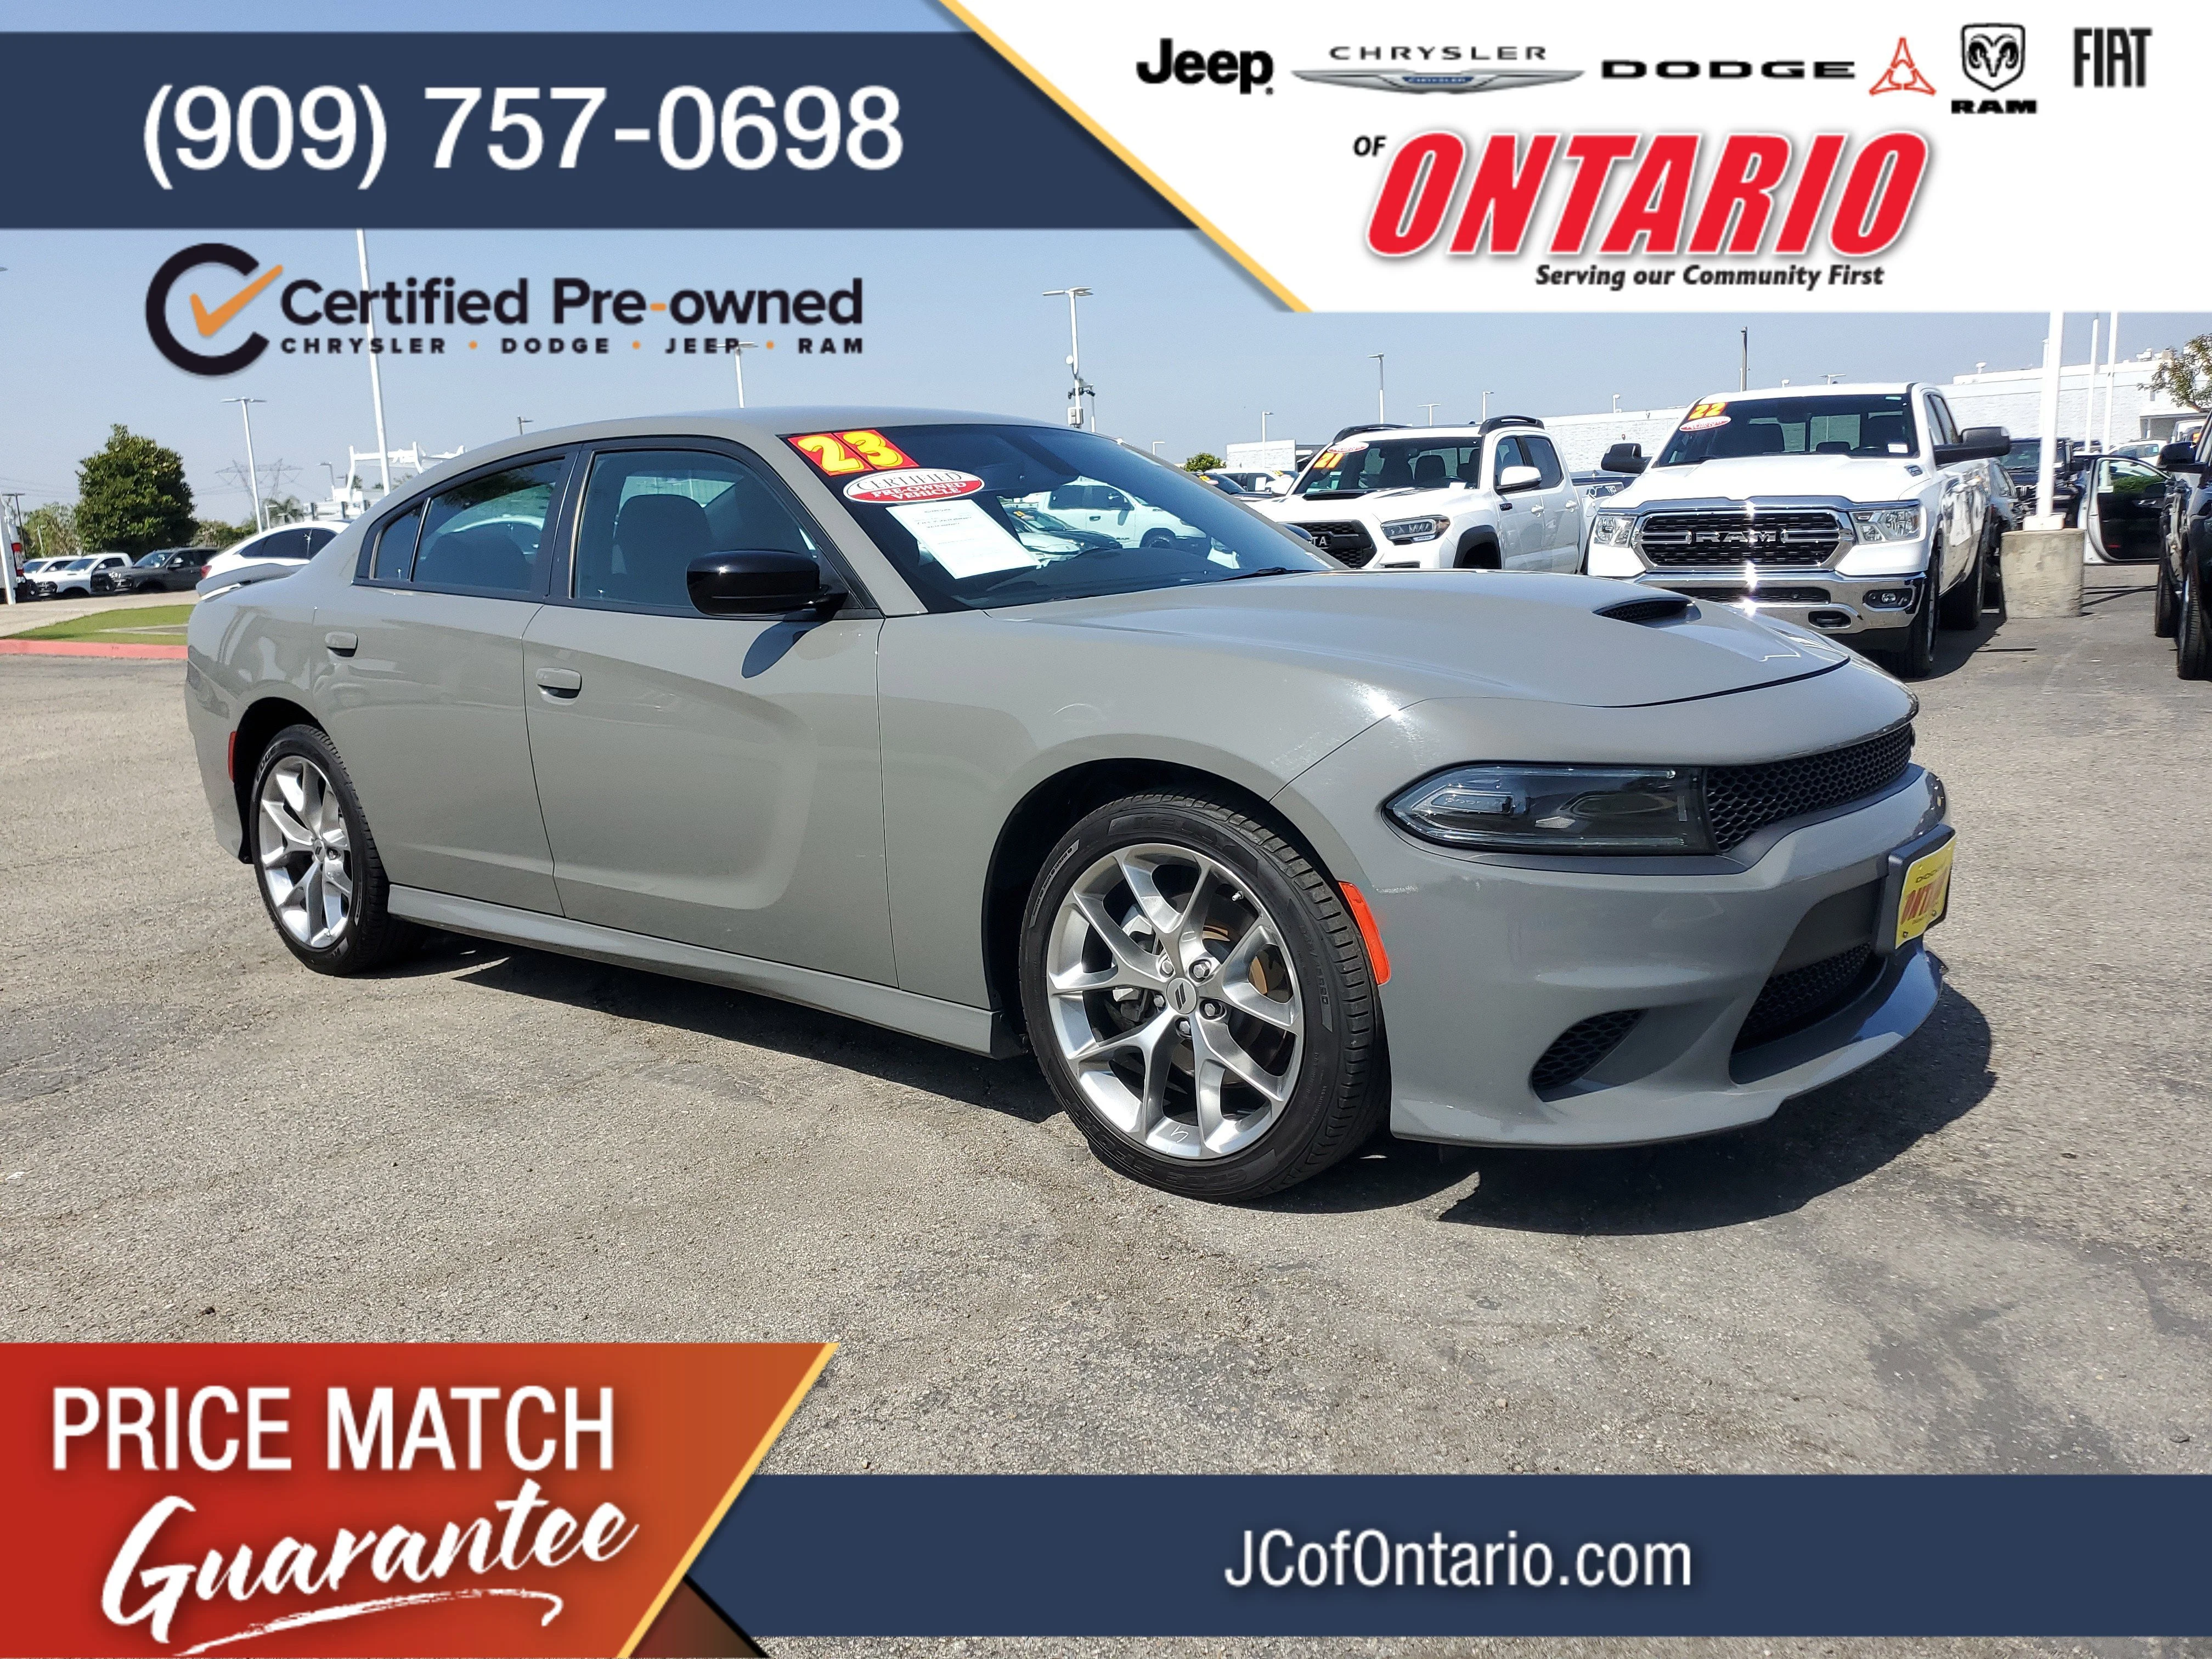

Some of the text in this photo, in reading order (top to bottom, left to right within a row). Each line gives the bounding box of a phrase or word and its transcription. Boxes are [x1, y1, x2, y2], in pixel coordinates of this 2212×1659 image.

[797, 431, 904, 473] 23
[856, 471, 963, 490] CERTIFIED
[872, 482, 967, 498] PRE-OWNED
[891, 487, 962, 500] VEHICLE
[1696, 531, 1776, 543] RAM
